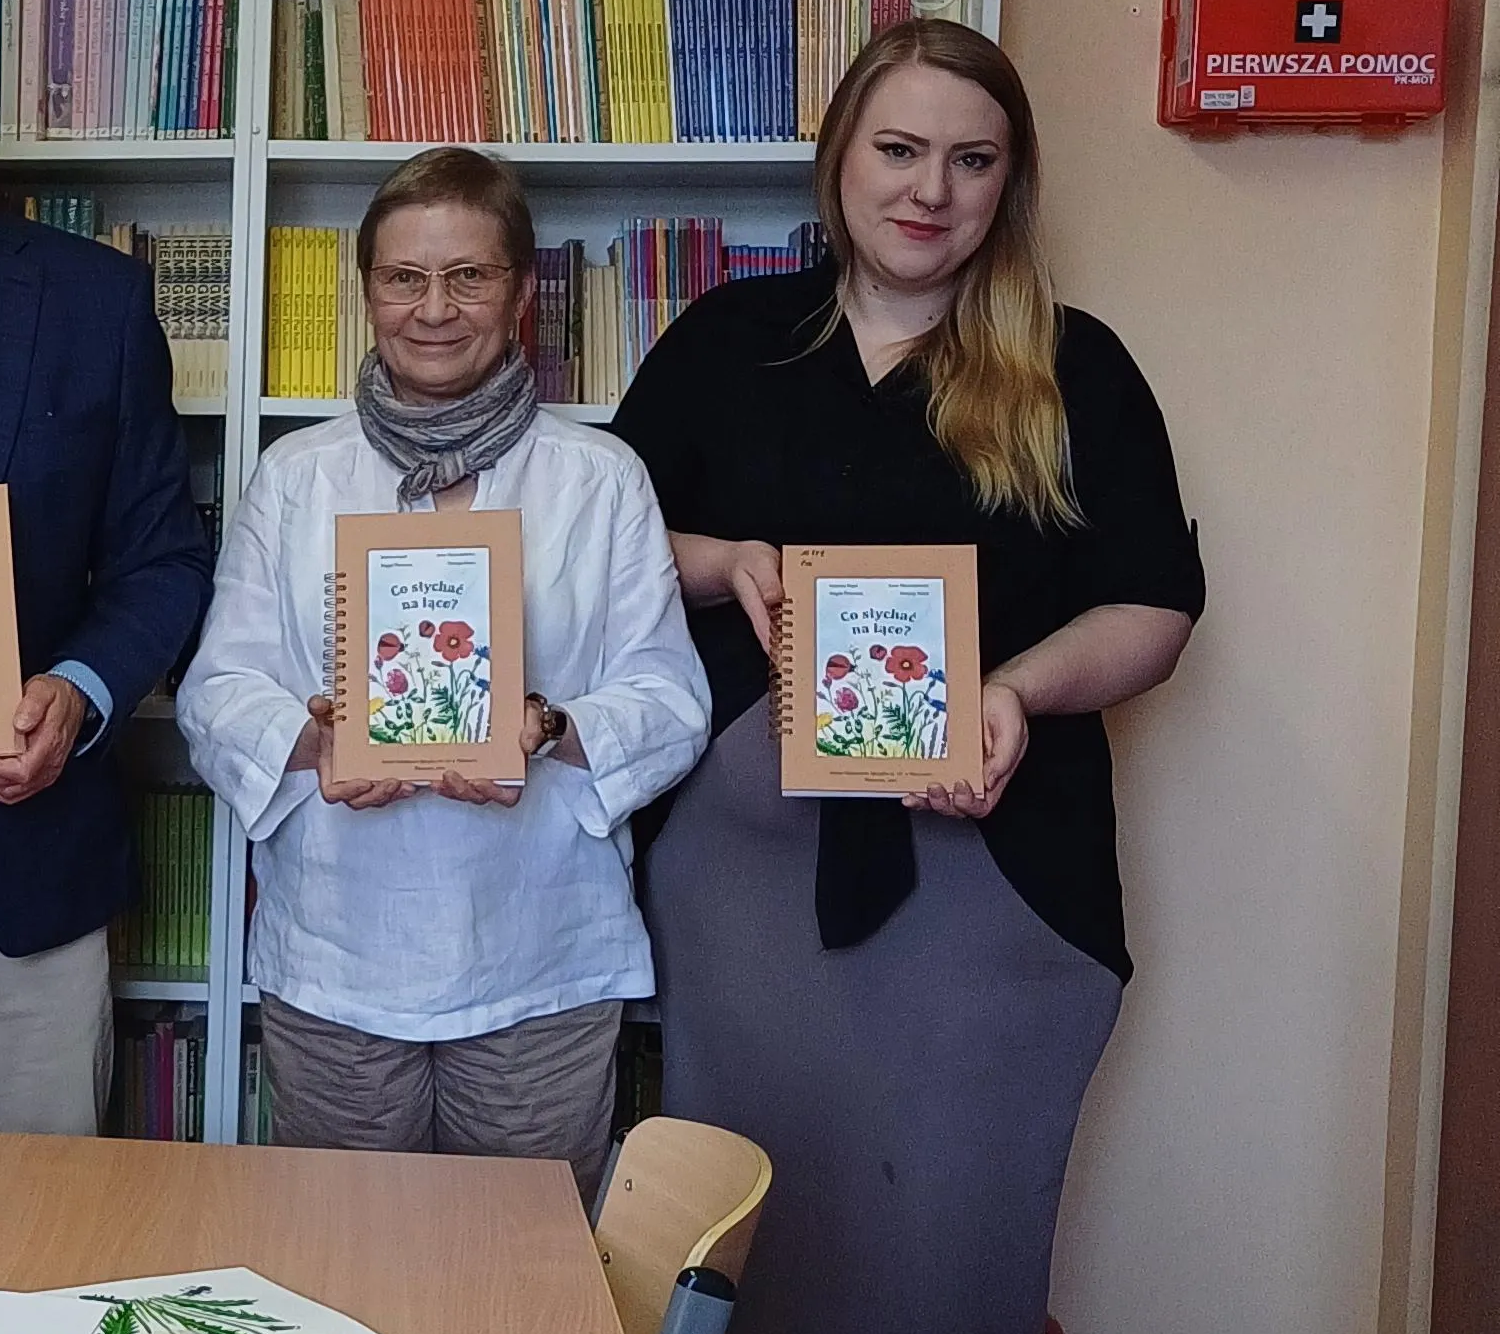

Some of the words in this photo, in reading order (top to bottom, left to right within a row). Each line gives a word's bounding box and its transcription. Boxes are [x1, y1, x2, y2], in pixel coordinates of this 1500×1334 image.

[1207, 54, 1333, 74] PIERWSZA
[1340, 54, 1436, 74] POMOC
[158, 239, 171, 324] HEMINGWAY
[171, 239, 184, 326] HEMINGWAY
[184, 239, 197, 326] HEMINGWAY
[197, 239, 210, 326] HEMINGWAY
[209, 239, 222, 326] HEMINGWAY
[390, 583, 409, 596] Co
[411, 581, 464, 596] słychać
[401, 599, 419, 611] na
[840, 610, 859, 622] Co
[862, 608, 917, 623] słychać
[852, 625, 870, 636] na
